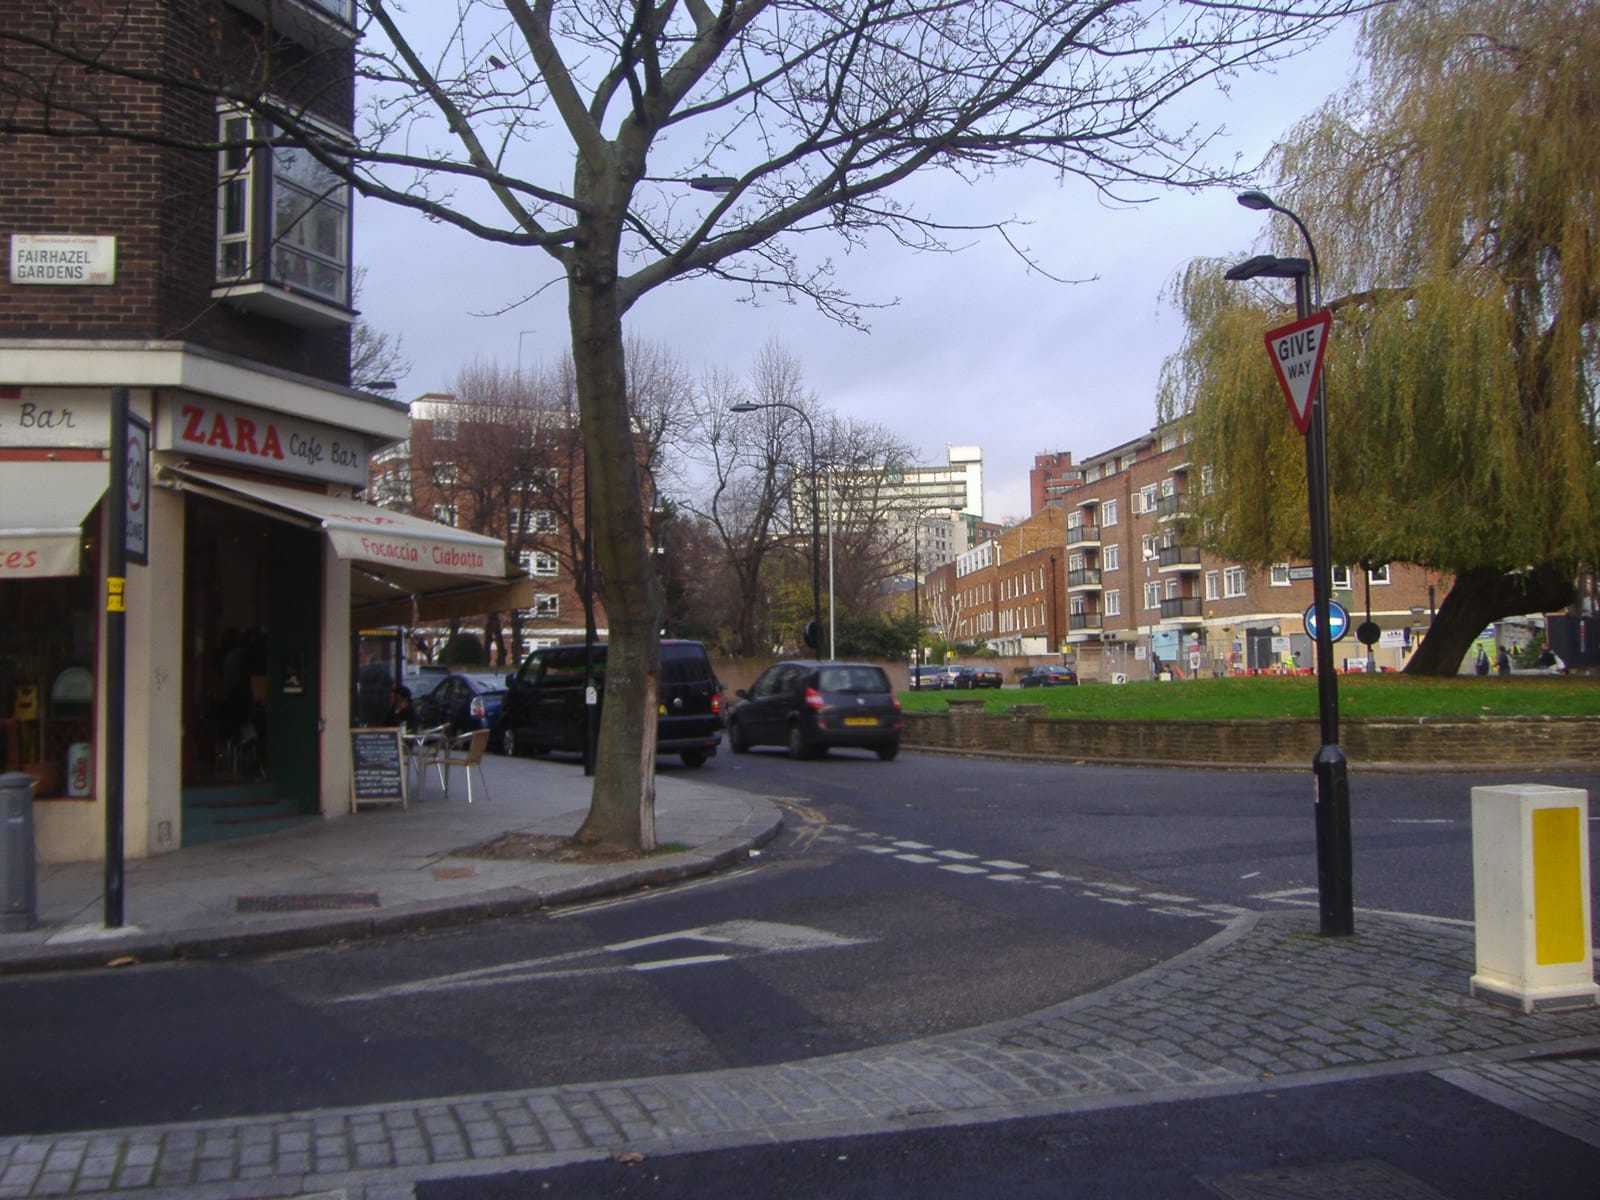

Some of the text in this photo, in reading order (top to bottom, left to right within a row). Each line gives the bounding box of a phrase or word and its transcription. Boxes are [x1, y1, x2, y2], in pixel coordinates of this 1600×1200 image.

[17, 249, 91, 264] FAIRHAZEL
[17, 265, 83, 279] GARDENS
[1278, 329, 1316, 361] GIVE
[1287, 360, 1311, 379] WAY
[19, 402, 77, 428] Bar
[182, 404, 358, 468] ZARA Cafe Bar
[128, 457, 141, 490] 20
[127, 519, 143, 541] ONE
[361, 536, 484, 568] Focaccia Ciabatta
